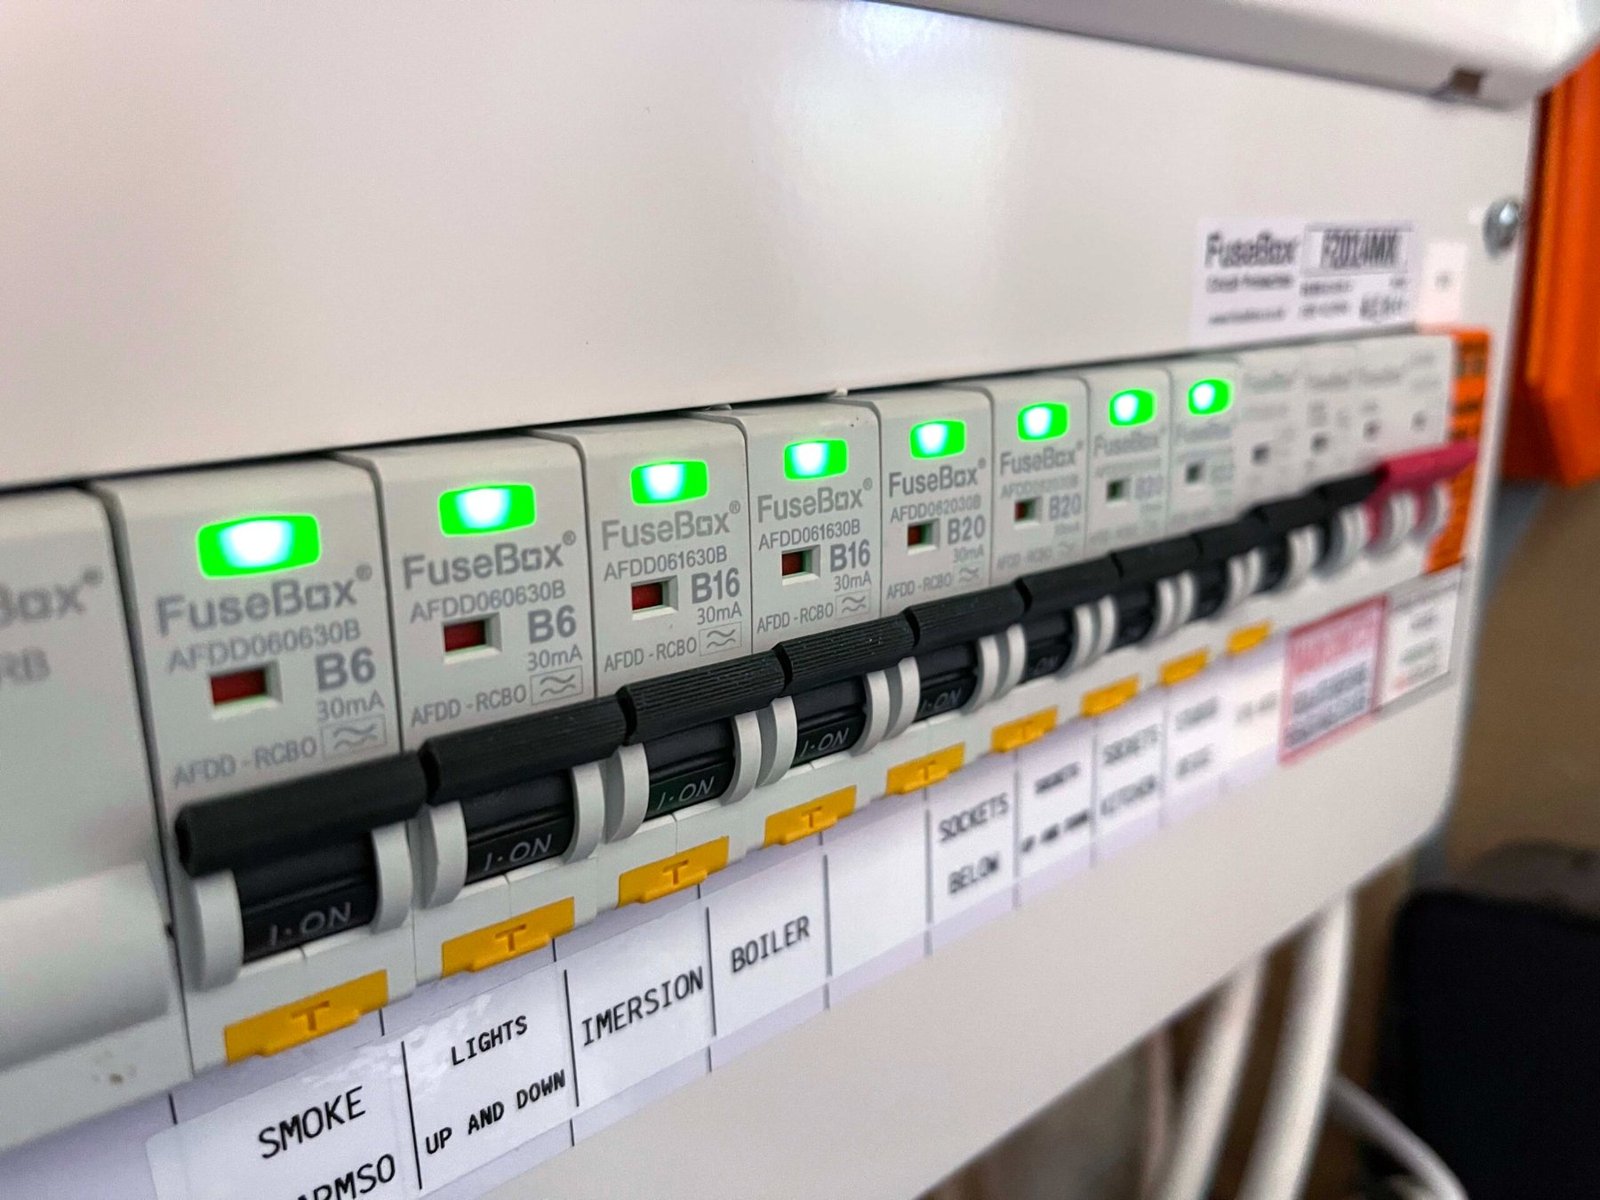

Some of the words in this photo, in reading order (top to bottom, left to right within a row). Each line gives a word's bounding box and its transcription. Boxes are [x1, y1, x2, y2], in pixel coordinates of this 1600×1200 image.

[1048, 494, 1082, 521] B20
[758, 519, 861, 551] AFDD061630B
[947, 515, 986, 545] B20
[603, 545, 727, 581] AFDD061630B
[830, 539, 871, 573] B16
[691, 567, 741, 604] B16
[834, 571, 872, 592] 30mA
[886, 581, 916, 600] AFDD
[411, 580, 566, 624] AFDD060630B
[697, 602, 742, 625] 30mA
[757, 612, 790, 634] AFDD
[800, 603, 834, 624] RCBO
[527, 605, 577, 644] B6
[169, 619, 361, 673] AFDD060630B
[527, 645, 583, 672] 30mA
[603, 647, 645, 672] AFDD
[656, 637, 697, 660] RCBO
[315, 647, 376, 693] B6
[317, 691, 384, 722] 30mA
[411, 700, 462, 727] AFDD
[476, 685, 527, 711] RCBO
[173, 754, 235, 789] AFDD
[938, 792, 1010, 843] SOCKETS
[948, 855, 999, 895] BELOW
[731, 915, 810, 973] BOILER
[581, 965, 704, 1047] IMERSION
[451, 1014, 529, 1066] LIGHTS
[257, 1085, 367, 1160] SMOKE
[425, 1126, 453, 1155] UP
[467, 1101, 505, 1136] AND
[515, 1070, 567, 1110] DOWN
[297, 1154, 396, 1200] RMSO
